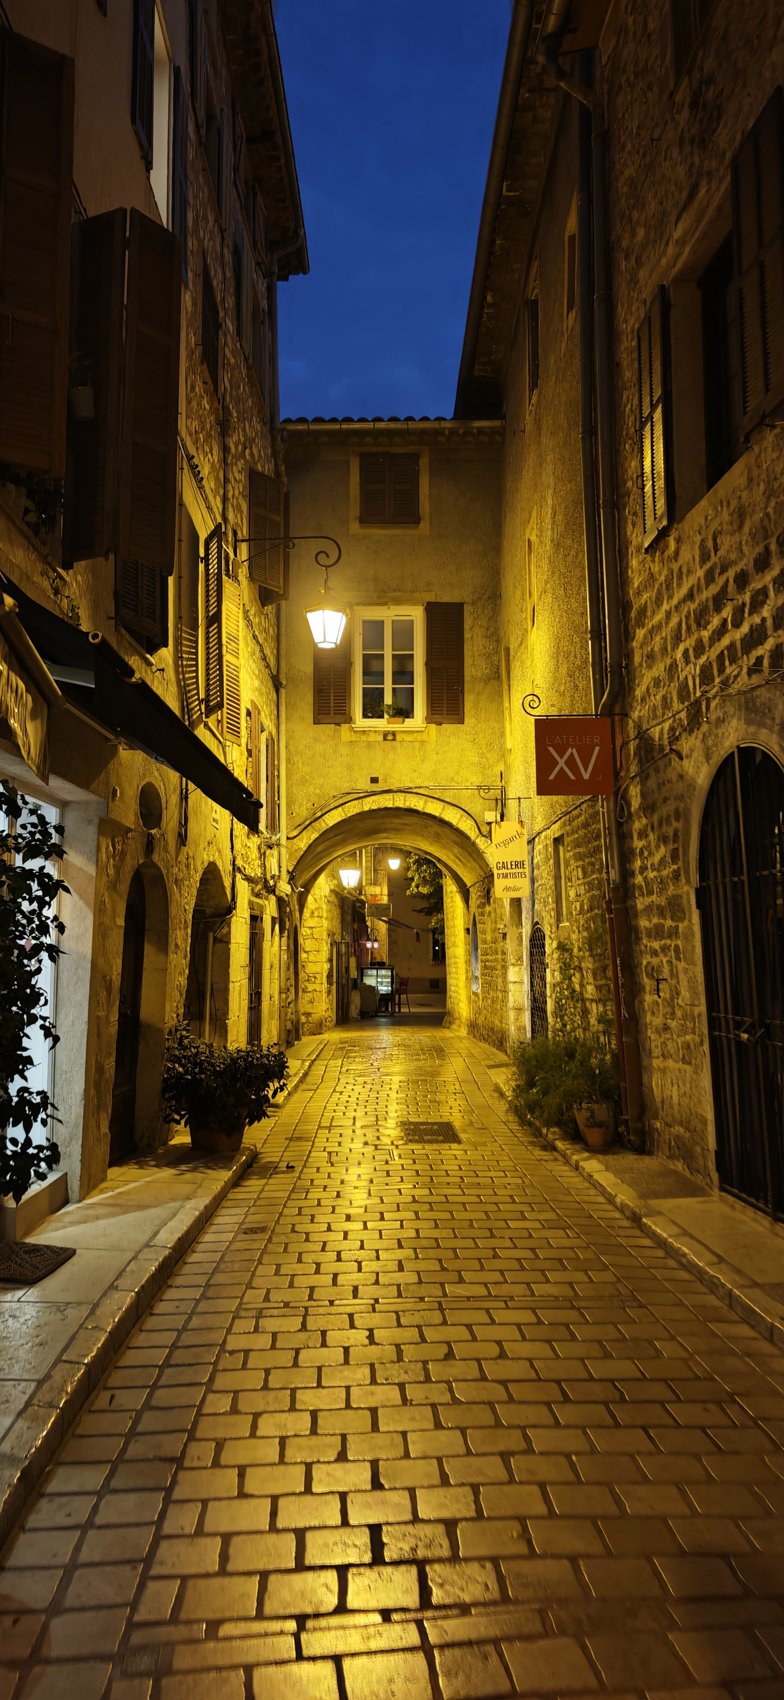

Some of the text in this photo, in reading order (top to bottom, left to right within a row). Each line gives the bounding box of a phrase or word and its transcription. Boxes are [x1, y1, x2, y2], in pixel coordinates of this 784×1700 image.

[545, 735, 601, 745] L'ATELIER
[546, 746, 601, 780] XV
[495, 829, 525, 849] regards
[496, 860, 526, 871] GALERIE
[496, 872, 527, 880] D'ARTISTES
[502, 884, 523, 892] Atelier
